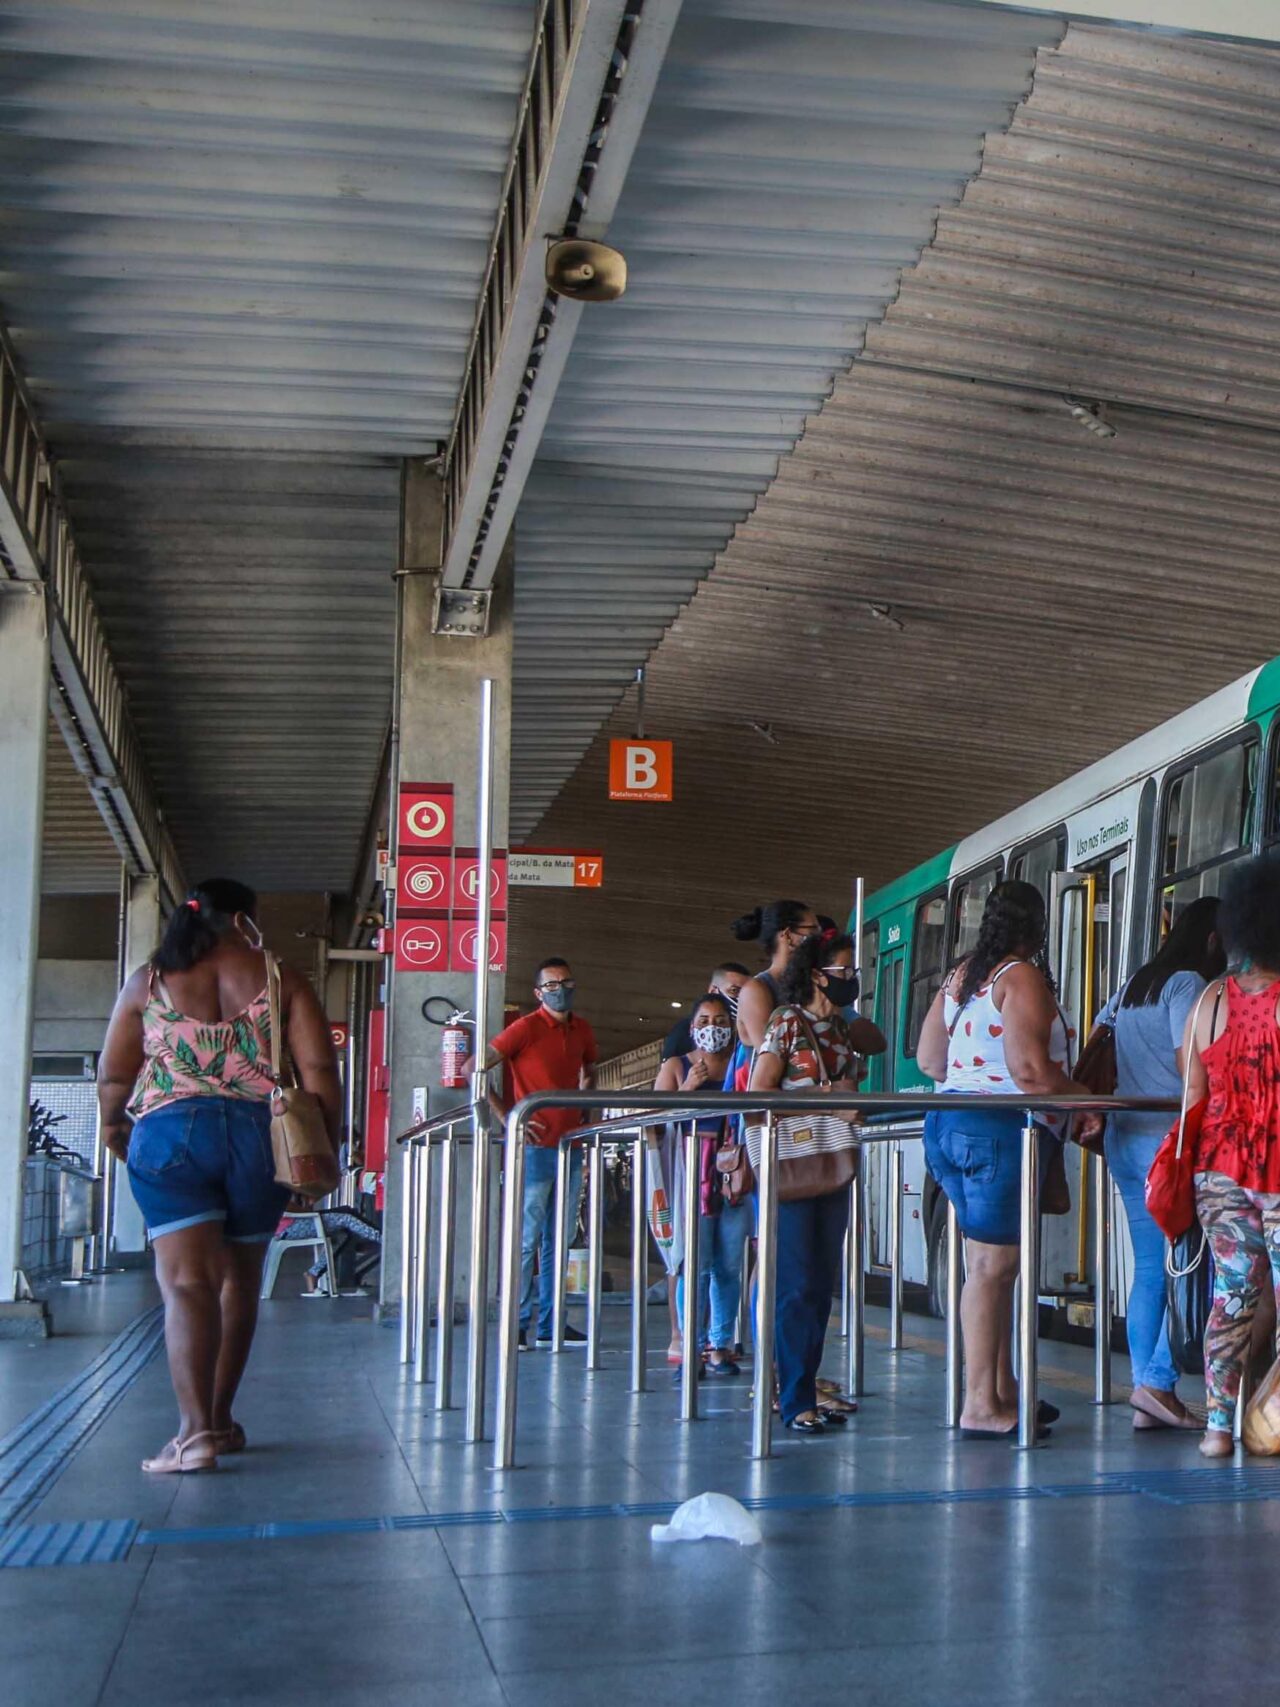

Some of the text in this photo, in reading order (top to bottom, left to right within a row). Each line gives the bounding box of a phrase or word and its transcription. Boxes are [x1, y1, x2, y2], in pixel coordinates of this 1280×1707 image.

[626, 746, 658, 789] B
[1077, 839, 1087, 856] Uso
[1088, 834, 1099, 850] nos
[578, 862, 599, 878] 17
